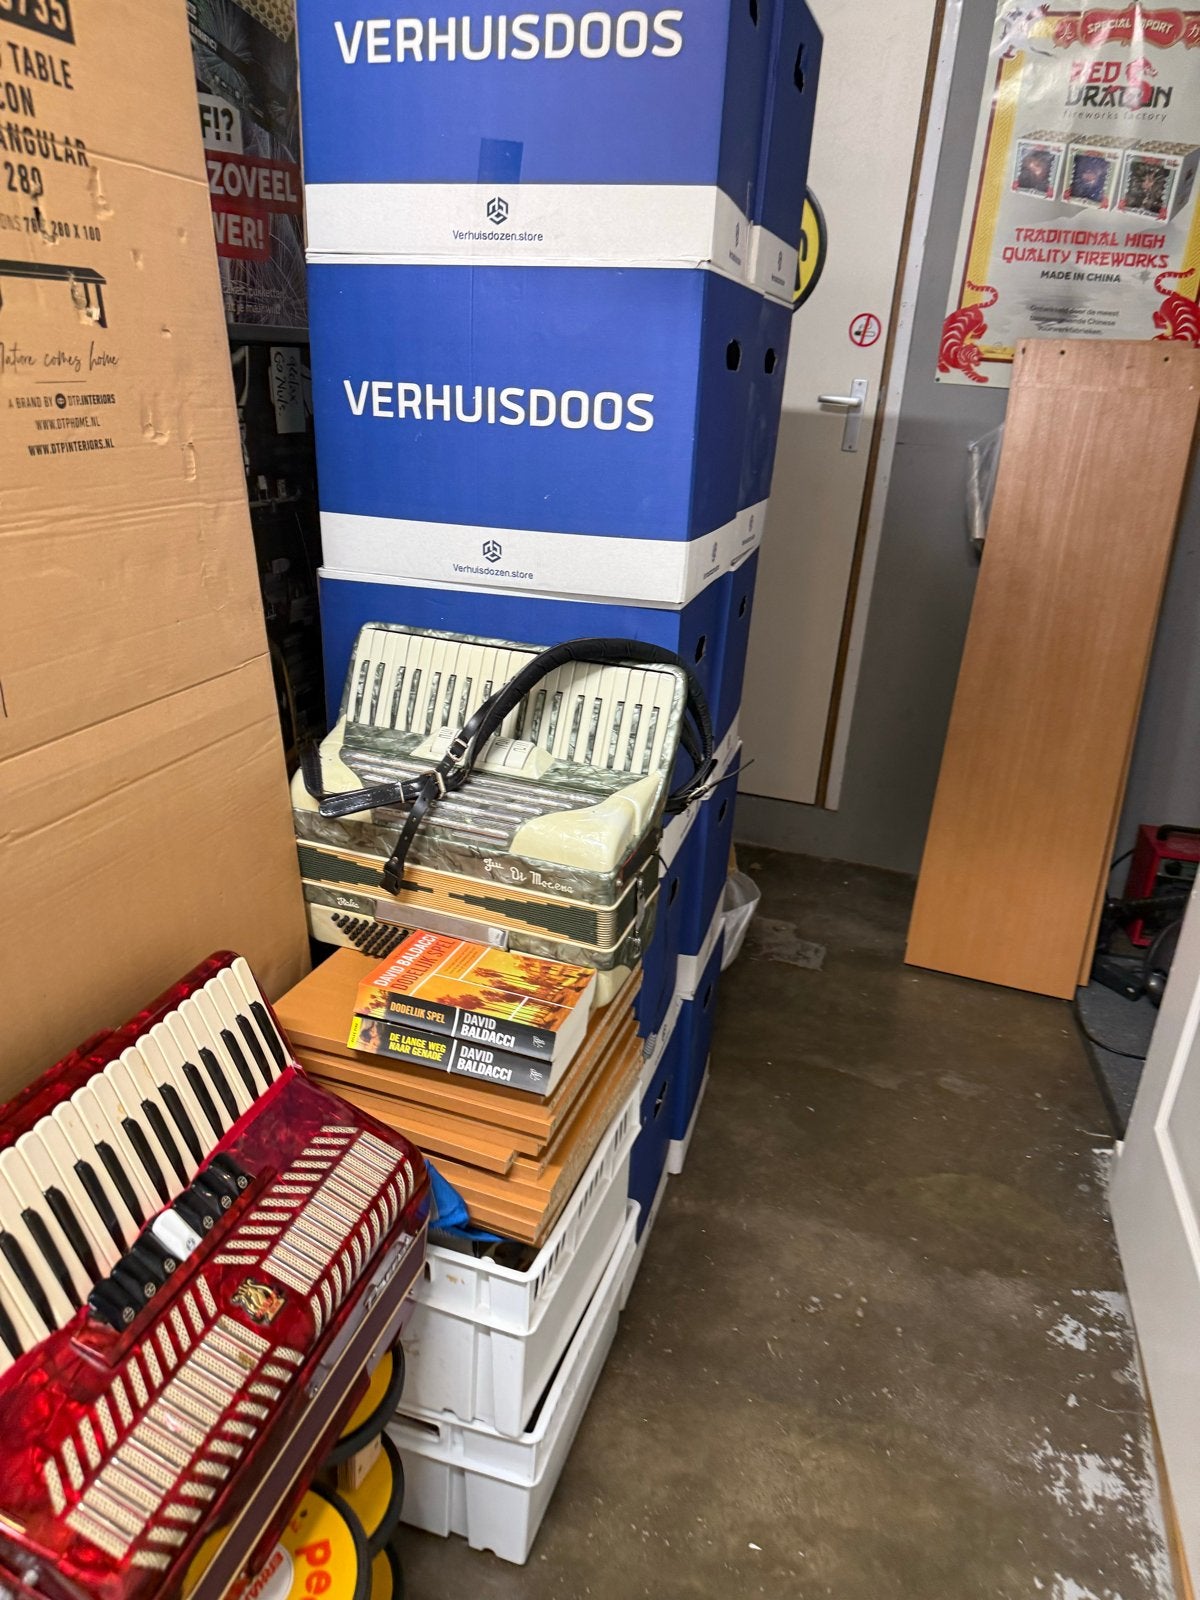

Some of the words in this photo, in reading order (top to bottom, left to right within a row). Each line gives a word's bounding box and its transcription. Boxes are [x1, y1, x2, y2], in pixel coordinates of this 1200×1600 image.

[335, 10, 683, 64] VERHUISDOOS
[7, 40, 74, 90] TABLE
[4, 160, 43, 199] 280
[207, 160, 297, 202] ZOVEEL
[73, 223, 80, 238] X
[83, 225, 101, 241] 100
[452, 229, 544, 241] Verhuisdozen.store
[1016, 228, 1118, 246] TRADITIONAL
[1125, 233, 1165, 248] HIGH
[1002, 247, 1071, 263] QUALITY
[1076, 251, 1169, 268] FIREWORKS
[1041, 270, 1071, 280] MADE
[1073, 272, 1084, 281] IN
[1086, 273, 1121, 282] CHINA
[344, 379, 655, 432] VERHUISDOOS
[452, 563, 534, 579] Verhuisdozen.store
[373, 965, 406, 987] DAVID
[397, 934, 440, 967] BALDACCI
[391, 957, 438, 991] DODELIJK
[428, 939, 456, 958] SPEL
[390, 1002, 426, 1019] DODELIJK
[426, 1010, 446, 1024] SPEL
[463, 1013, 497, 1030] DAVID
[389, 1033, 401, 1043] DE
[401, 1035, 427, 1048] LANGE
[428, 1041, 447, 1053] WEG
[460, 1024, 516, 1048] BALDACCI
[388, 1041, 411, 1054] NAAR
[411, 1047, 444, 1061] GENADE
[459, 1046, 494, 1063] DAVID
[457, 1058, 513, 1081] BALDACCI
